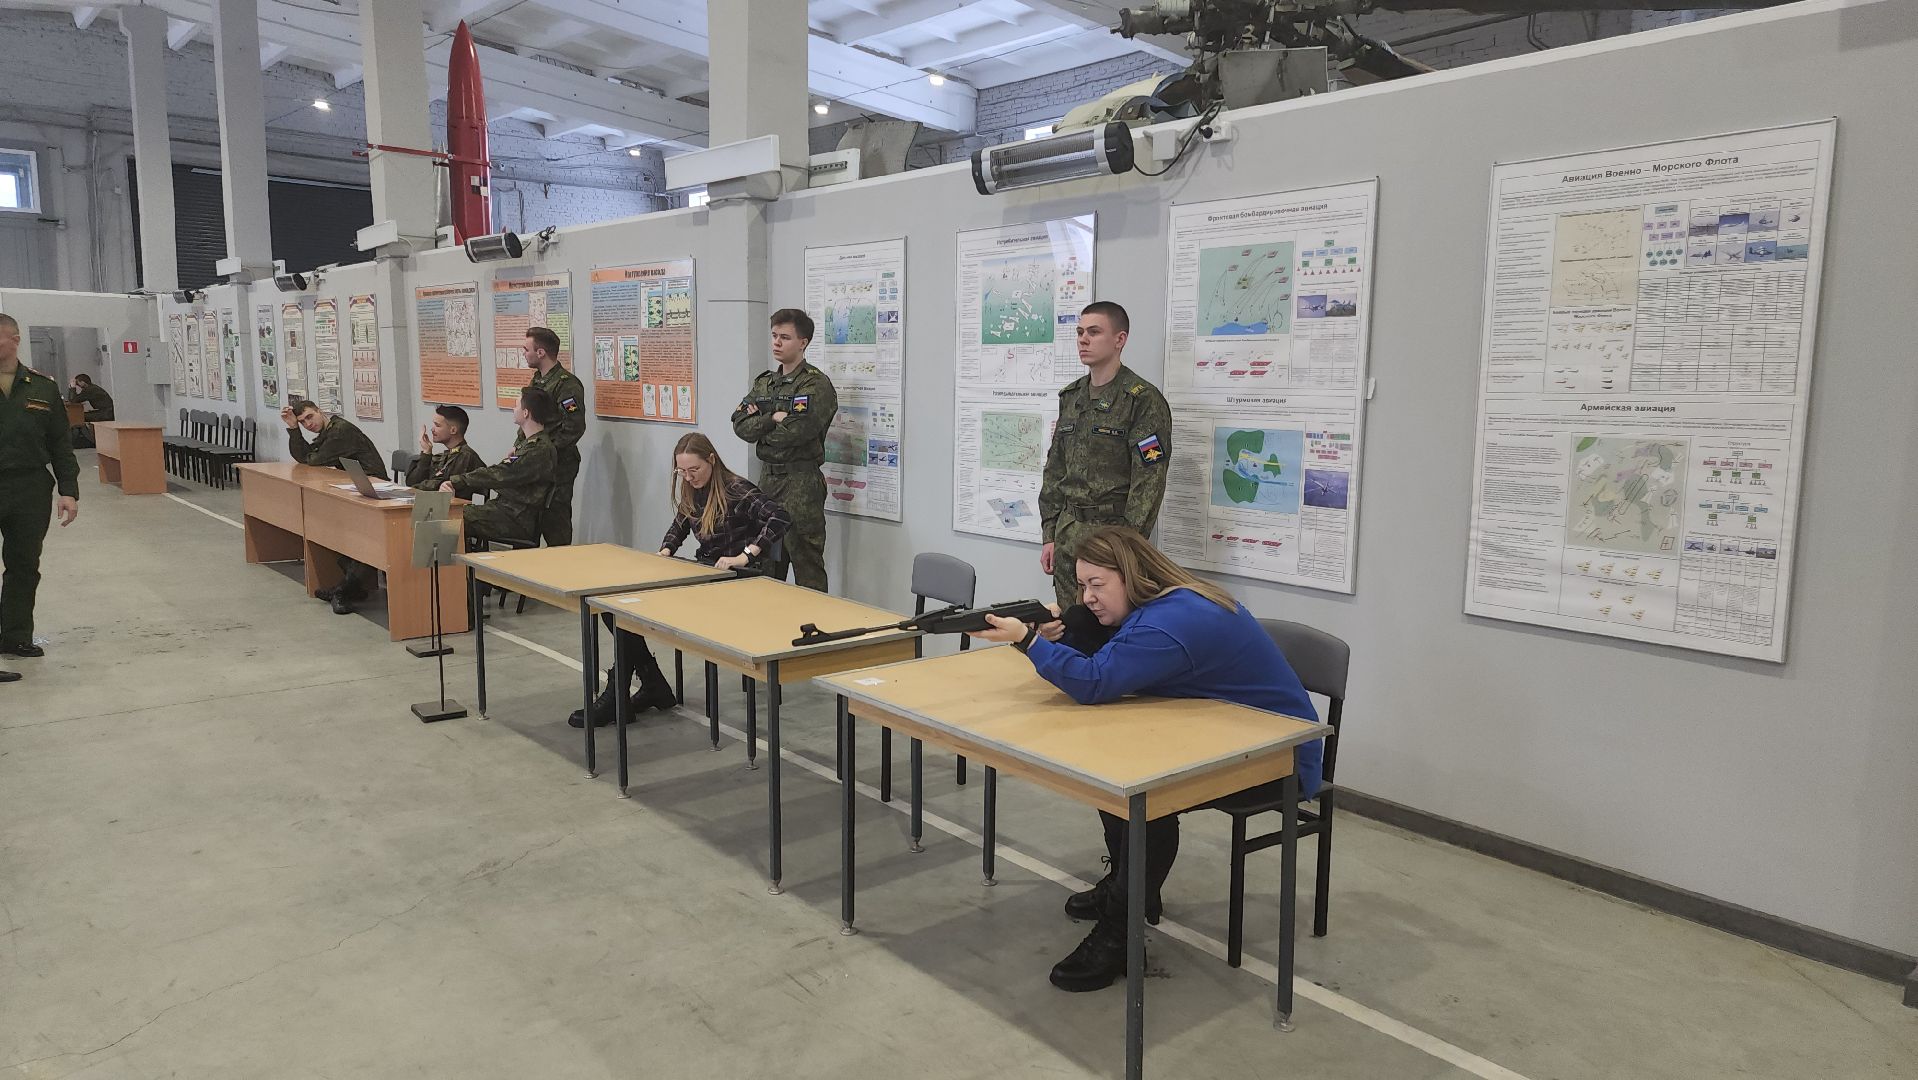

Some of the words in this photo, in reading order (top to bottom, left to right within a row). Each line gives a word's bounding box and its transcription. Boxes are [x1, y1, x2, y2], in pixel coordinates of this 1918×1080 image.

[1562, 172, 1603, 183] Авиация
[1605, 167, 1642, 178] Военно
[1652, 160, 1702, 173] Морского
[1705, 156, 1739, 167] Флота
[1580, 403, 1632, 412] Армейская
[1634, 405, 1676, 413] авиация
